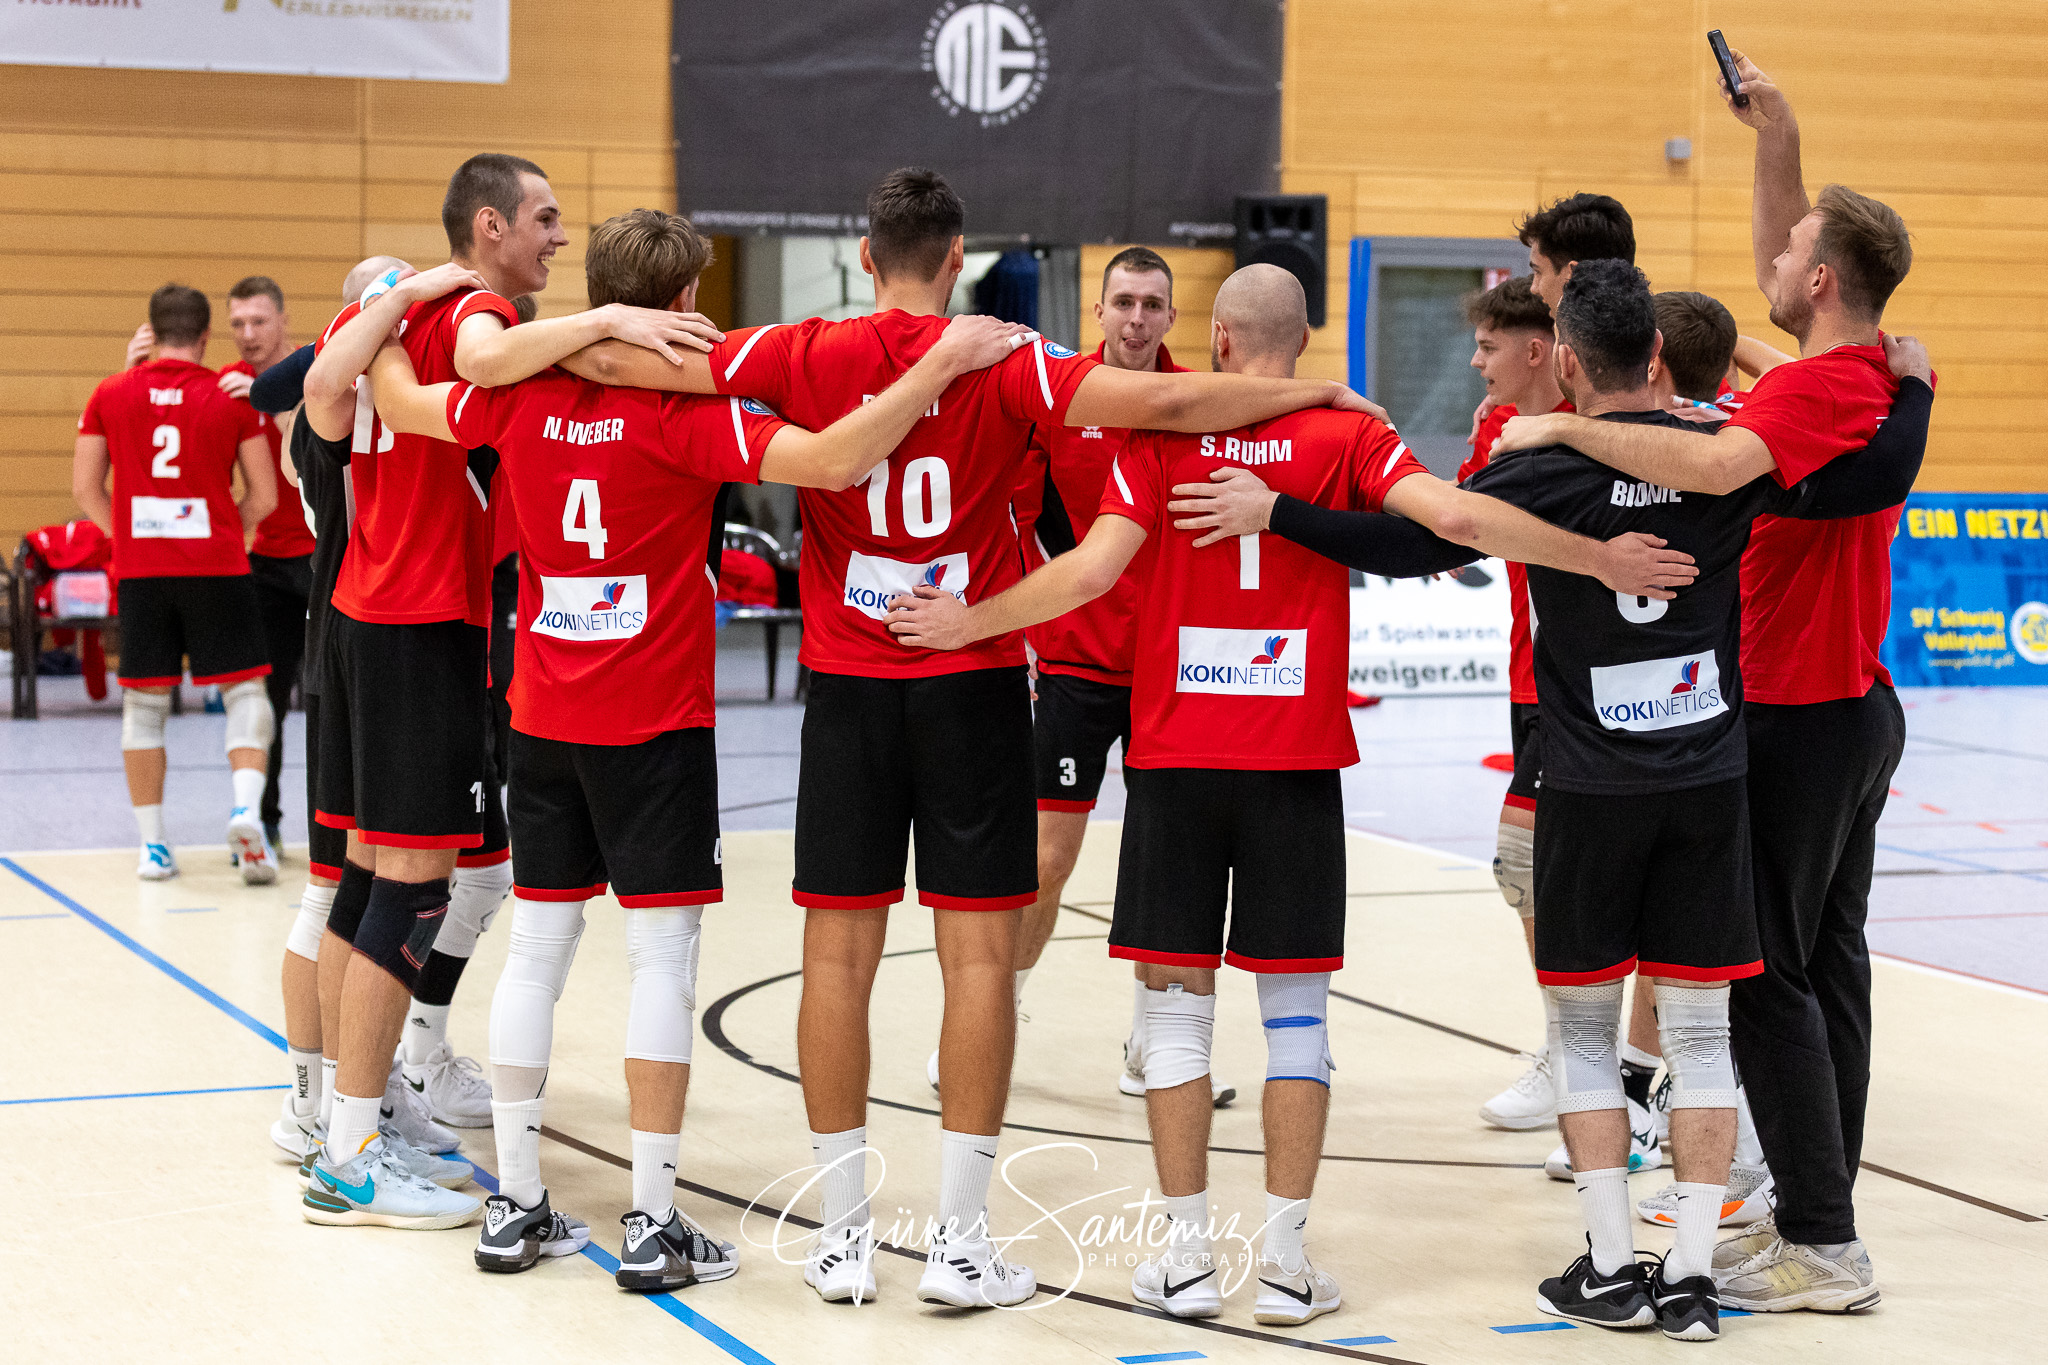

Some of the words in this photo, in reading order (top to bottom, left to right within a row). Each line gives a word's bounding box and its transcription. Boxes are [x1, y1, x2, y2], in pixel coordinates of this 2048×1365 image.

[352, 373, 395, 454] 1
[543, 415, 625, 446] N.WEBER
[152, 424, 181, 479] 2
[1200, 435, 1293, 466] S.RUHM
[854, 457, 952, 538] 10
[562, 478, 608, 560] 4
[1907, 508, 1958, 539] EIN
[539, 610, 643, 631] KOKINETICS
[1180, 663, 1303, 685] KOKINETICS
[1600, 688, 1720, 723] KOKINETICS
[1059, 757, 1077, 786] 3
